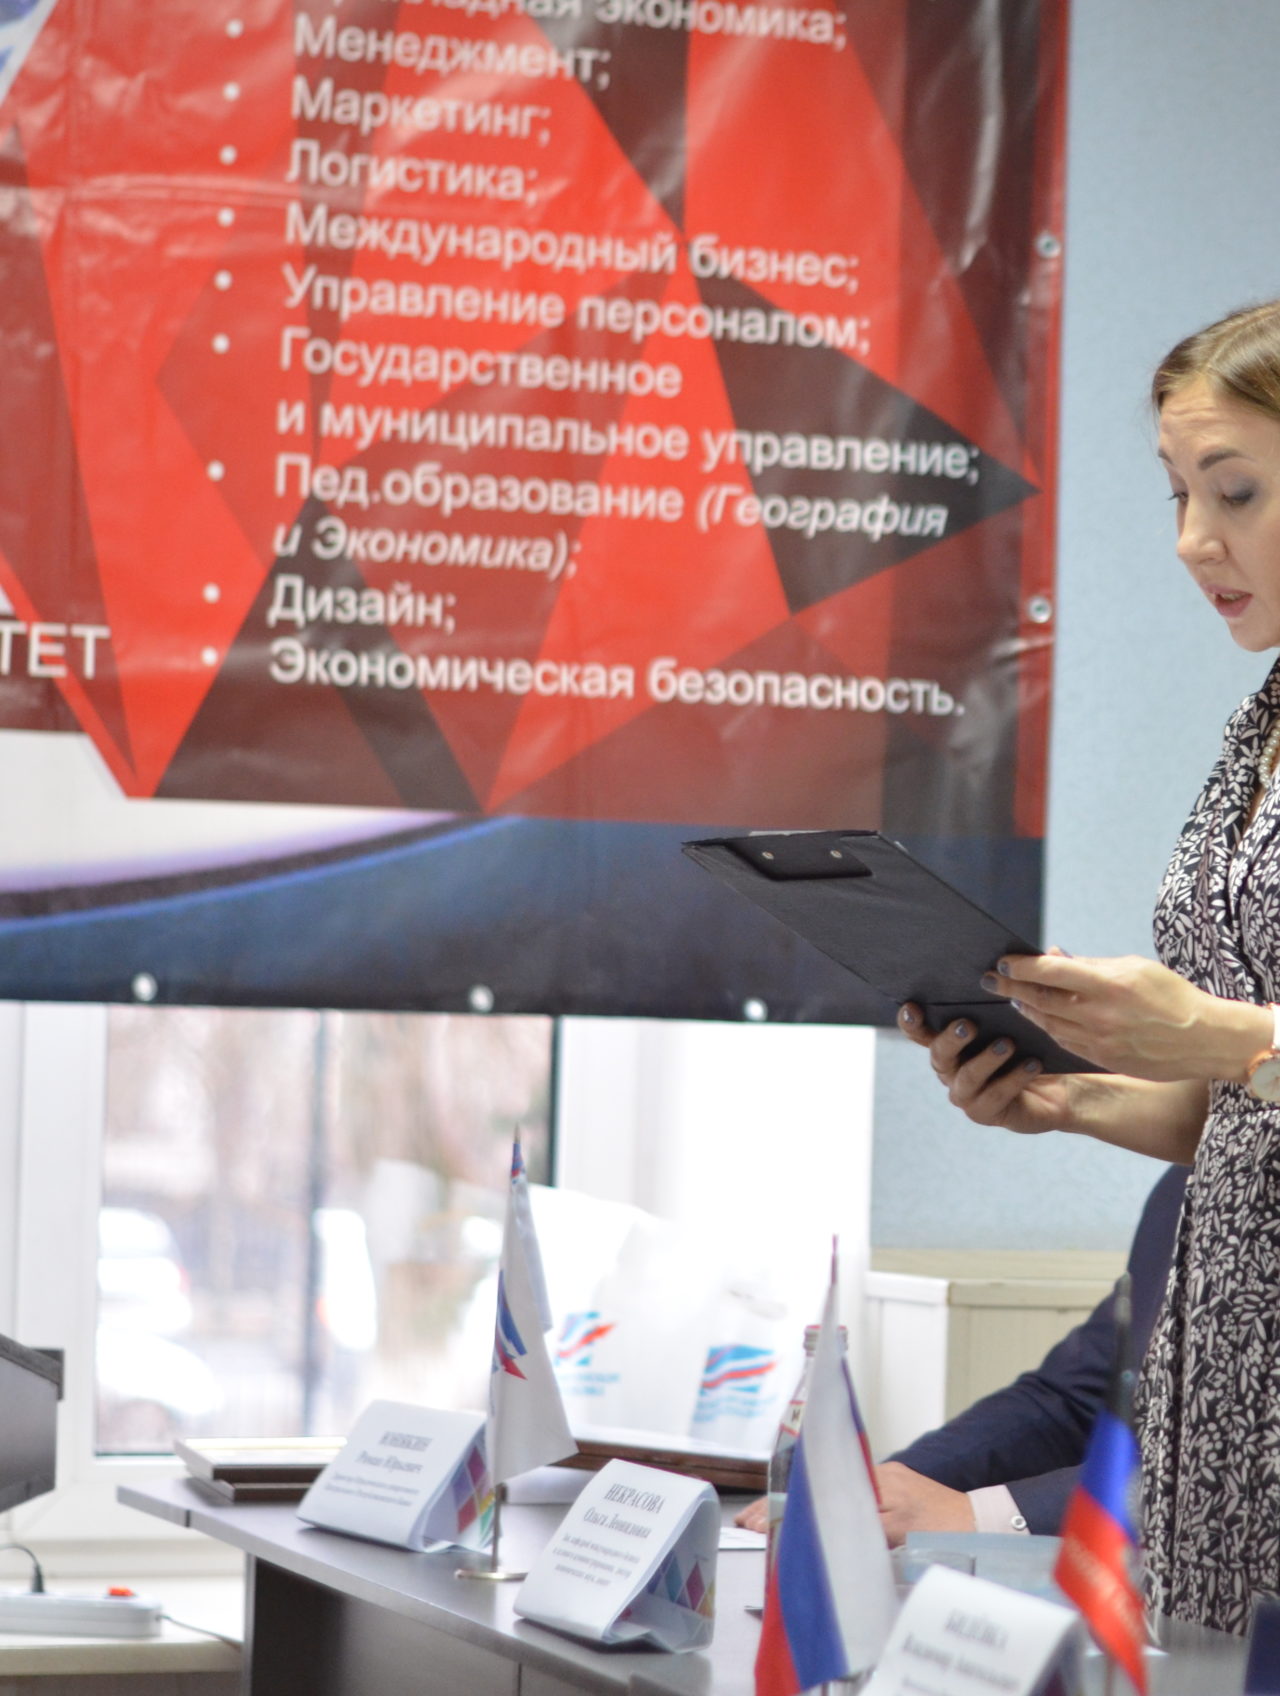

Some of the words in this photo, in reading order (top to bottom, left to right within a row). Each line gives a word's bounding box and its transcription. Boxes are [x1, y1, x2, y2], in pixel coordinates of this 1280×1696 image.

[295, 11, 611, 91] Менеджмент;
[596, 0, 847, 51] экономика;
[291, 74, 551, 147] Маркетинг;
[285, 137, 538, 206] Логистика;
[285, 201, 678, 275] Международный
[689, 232, 859, 295] бизнес;
[281, 261, 566, 328] Управление
[577, 295, 870, 355] персоналом;
[278, 325, 682, 398] Государственное
[276, 399, 306, 435] и
[319, 402, 690, 461] муниципальное
[701, 428, 980, 486] управление;
[275, 452, 685, 523] Пед.образование
[696, 484, 949, 543] (География
[273, 523, 303, 557] и
[312, 514, 582, 582] Экономика);
[267, 573, 457, 636] Дизайн;
[269, 635, 636, 700] Экономическая
[648, 656, 966, 718] безопасность.
[604, 1483, 665, 1515] НЕКРАСОВА
